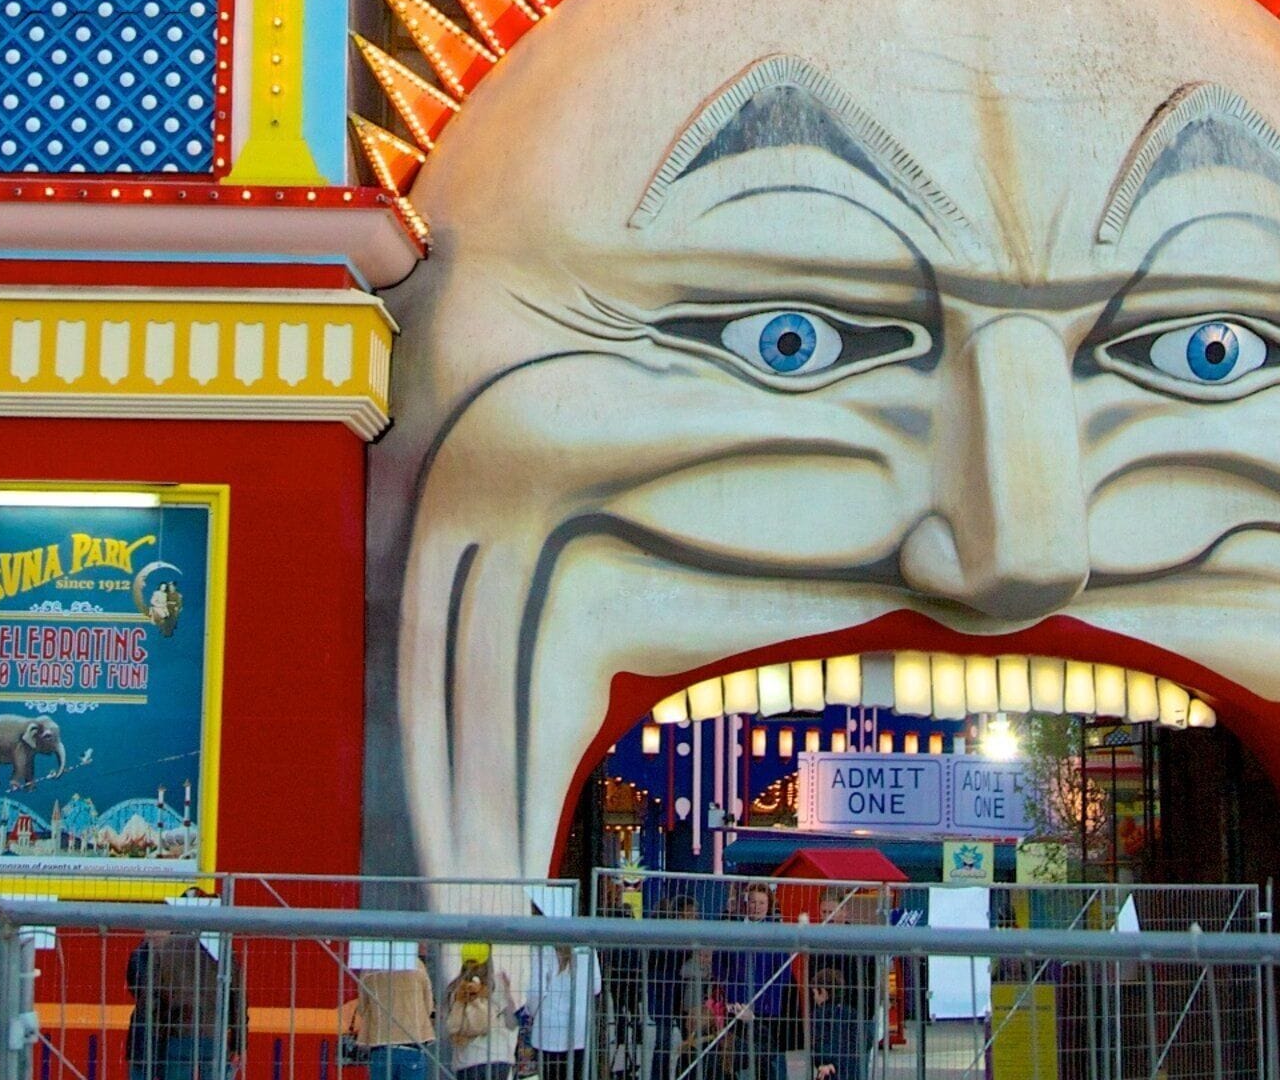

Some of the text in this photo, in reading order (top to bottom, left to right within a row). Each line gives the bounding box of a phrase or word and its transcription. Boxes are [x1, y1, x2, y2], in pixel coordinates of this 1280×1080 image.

[69, 533, 156, 574] PARK
[56, 576, 131, 592] since 1912
[18, 662, 74, 688] YEARS
[80, 663, 103, 688] OF
[108, 663, 148, 690] FUN!
[832, 768, 925, 789] ADMIT
[962, 770, 1023, 794] ADMIT
[848, 792, 906, 815] ONE
[975, 796, 1005, 819] ONE
